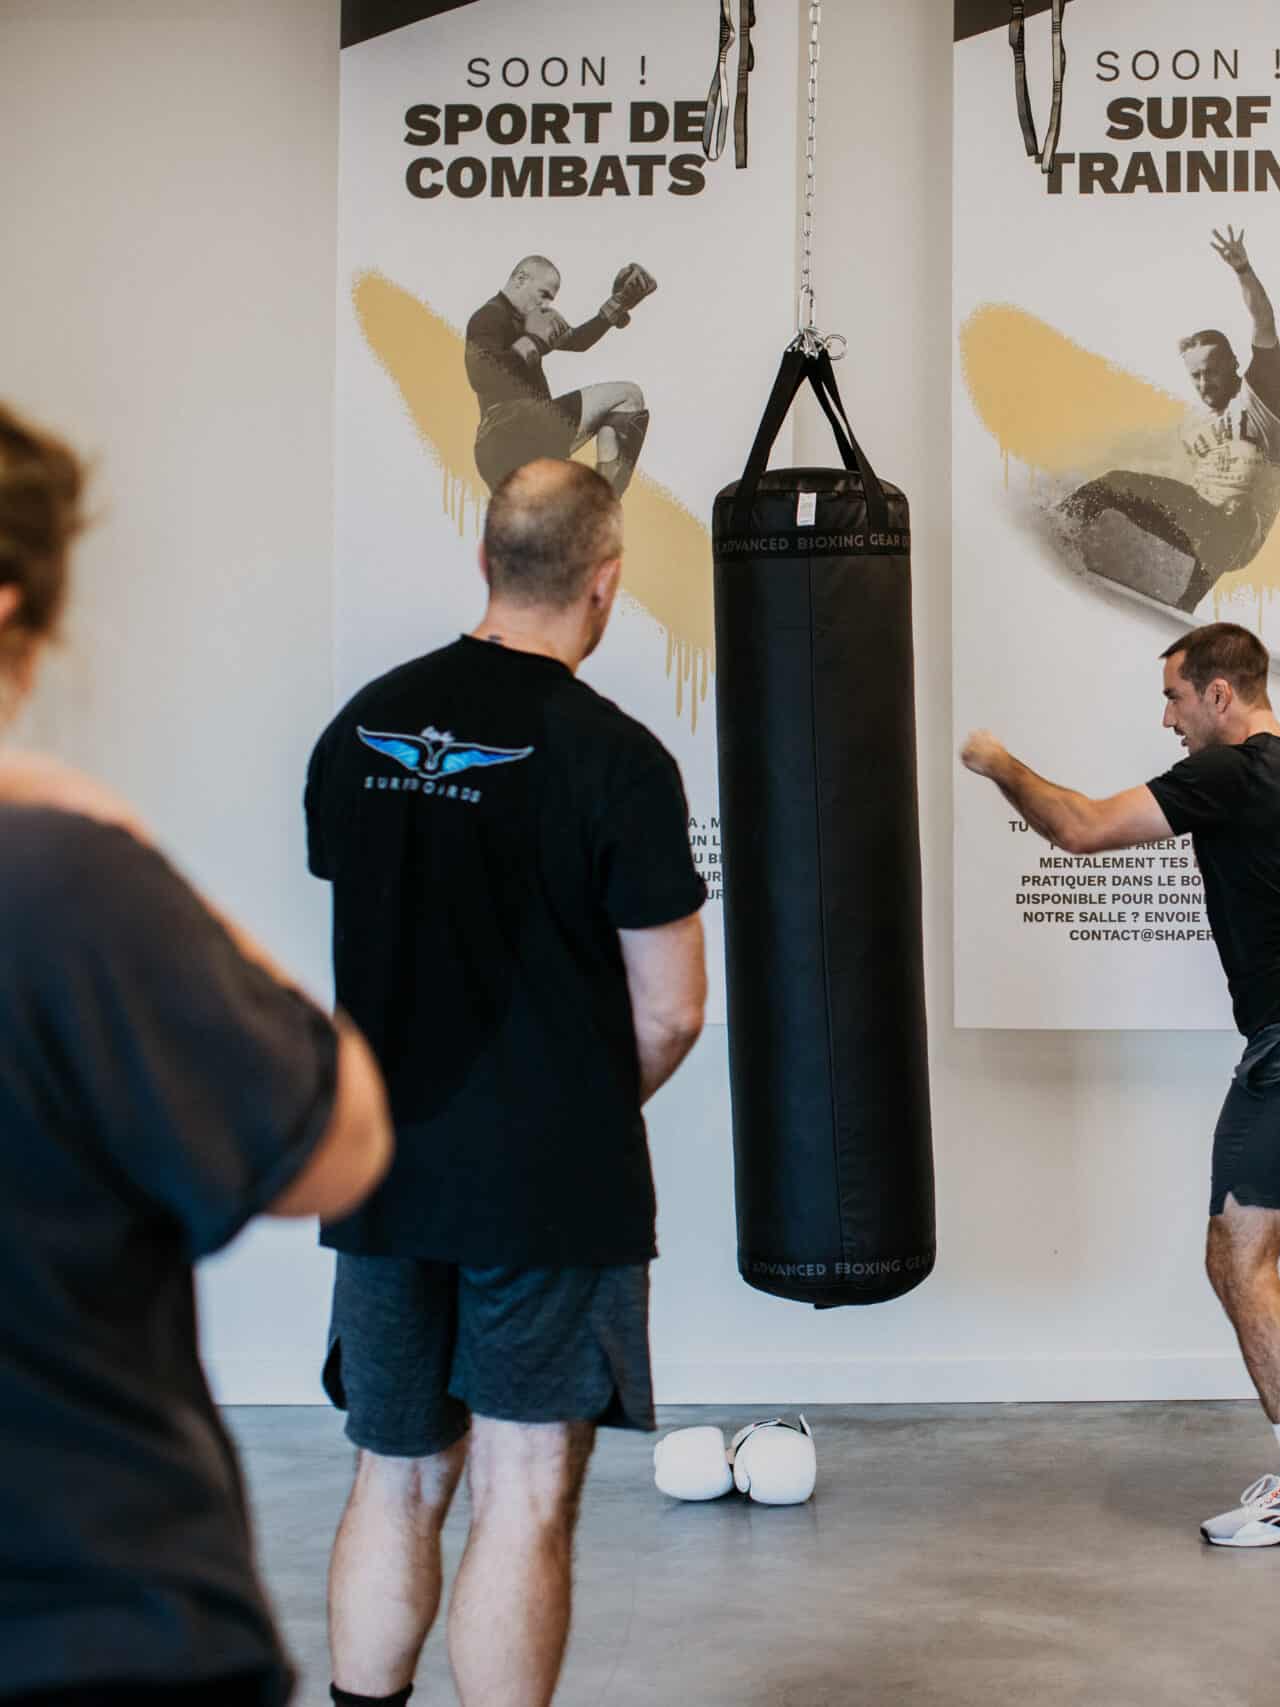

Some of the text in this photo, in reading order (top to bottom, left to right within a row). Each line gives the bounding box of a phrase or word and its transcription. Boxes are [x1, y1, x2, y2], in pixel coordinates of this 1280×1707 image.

[466, 55, 646, 89] SOON !
[1095, 48, 1280, 83] SOON !
[403, 100, 707, 147] SPORT DE
[1105, 95, 1272, 141] SURF
[405, 151, 707, 200] COMBATS
[1008, 820, 1029, 833] TU
[1039, 856, 1156, 869] MENTALEMENT
[1159, 856, 1189, 869] TES
[1021, 874, 1107, 890] PRATIQUER
[1111, 874, 1153, 887] DANS
[1157, 875, 1177, 887] LE
[1015, 892, 1107, 905] DISPONIBLE
[1111, 893, 1154, 905] POUR
[1023, 911, 1201, 923] NOTRE SALLE ? ENVOIE
